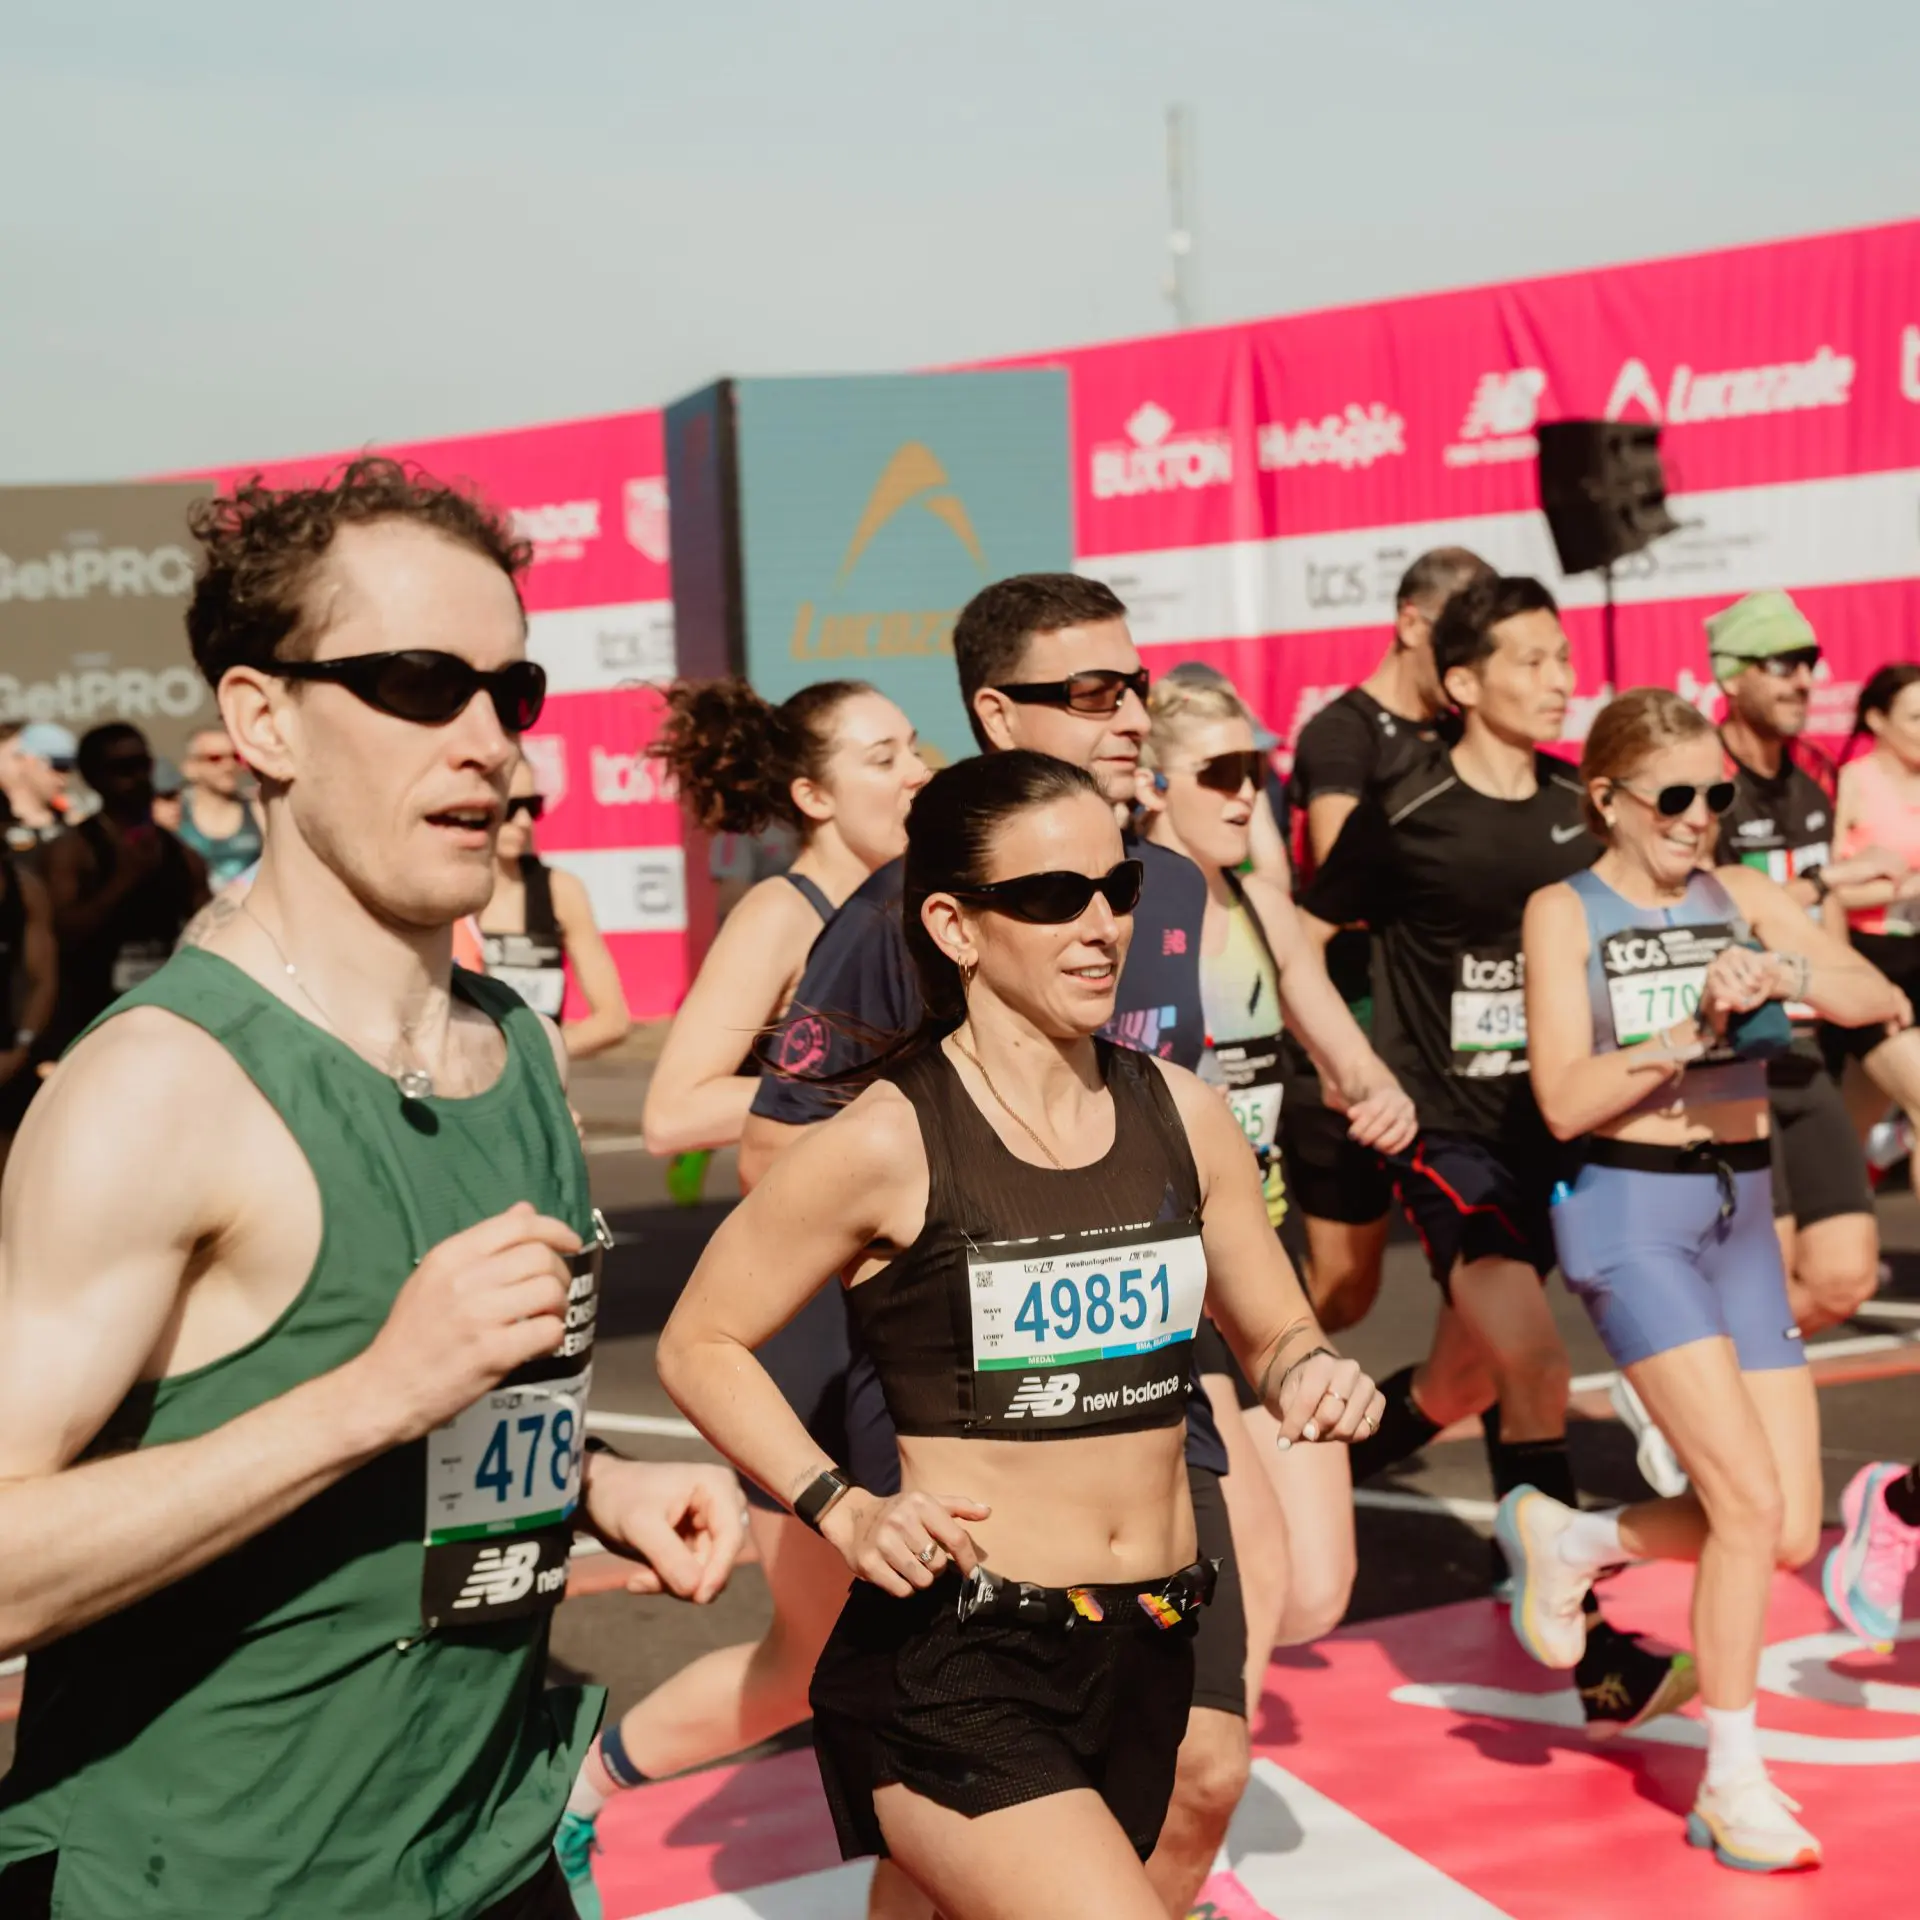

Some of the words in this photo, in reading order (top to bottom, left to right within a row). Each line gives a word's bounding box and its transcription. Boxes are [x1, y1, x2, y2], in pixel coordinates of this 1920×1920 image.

[1667, 347, 1855, 425] Lucozade
[1258, 402, 1405, 471] HubSpot
[1092, 441, 1233, 498] BUXTON
[1462, 954, 1515, 989] tcs
[1014, 1263, 1170, 1343] 49851
[1028, 1356, 1056, 1365] MEDAL
[1083, 1393, 1118, 1412] new
[1123, 1375, 1179, 1406] balance
[475, 1409, 577, 1502] 478
